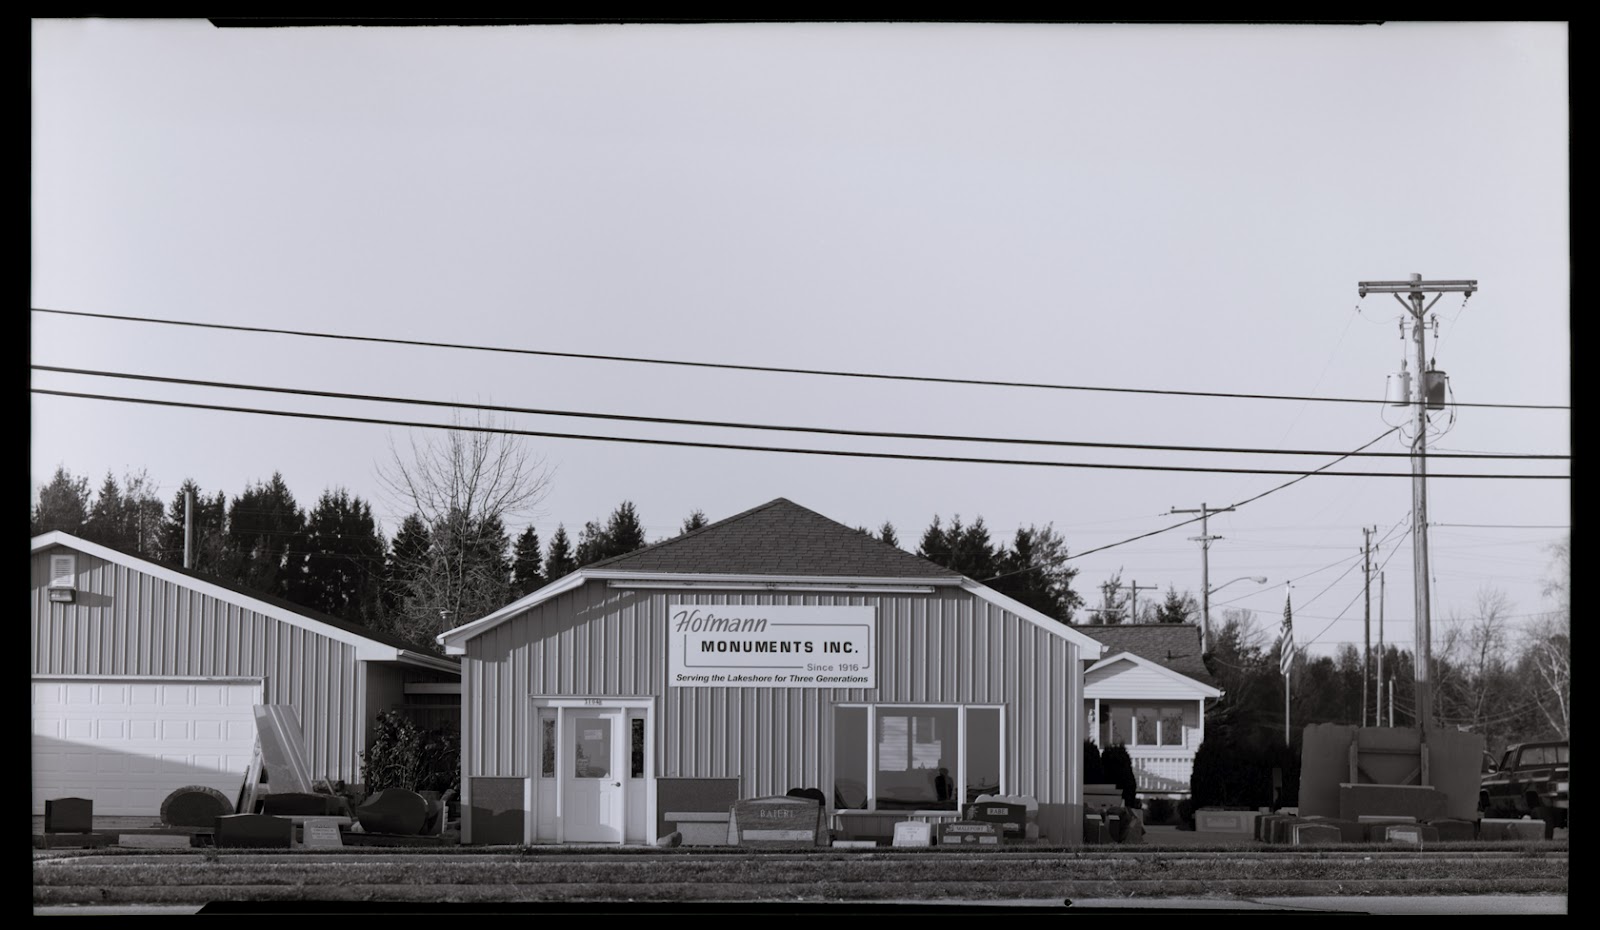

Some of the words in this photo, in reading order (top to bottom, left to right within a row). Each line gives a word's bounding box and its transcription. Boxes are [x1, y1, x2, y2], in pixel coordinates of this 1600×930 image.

[673, 609, 768, 633] Hofmann
[701, 640, 814, 653] MONUMENTS
[823, 641, 859, 653] INC.
[806, 663, 834, 672] Since
[838, 663, 859, 672] 1916
[676, 673, 709, 683] Serving
[711, 674, 725, 682] the
[727, 674, 773, 683] Lakeshore
[774, 674, 787, 683] for
[789, 674, 814, 683] Three
[815, 675, 869, 684] Generations
